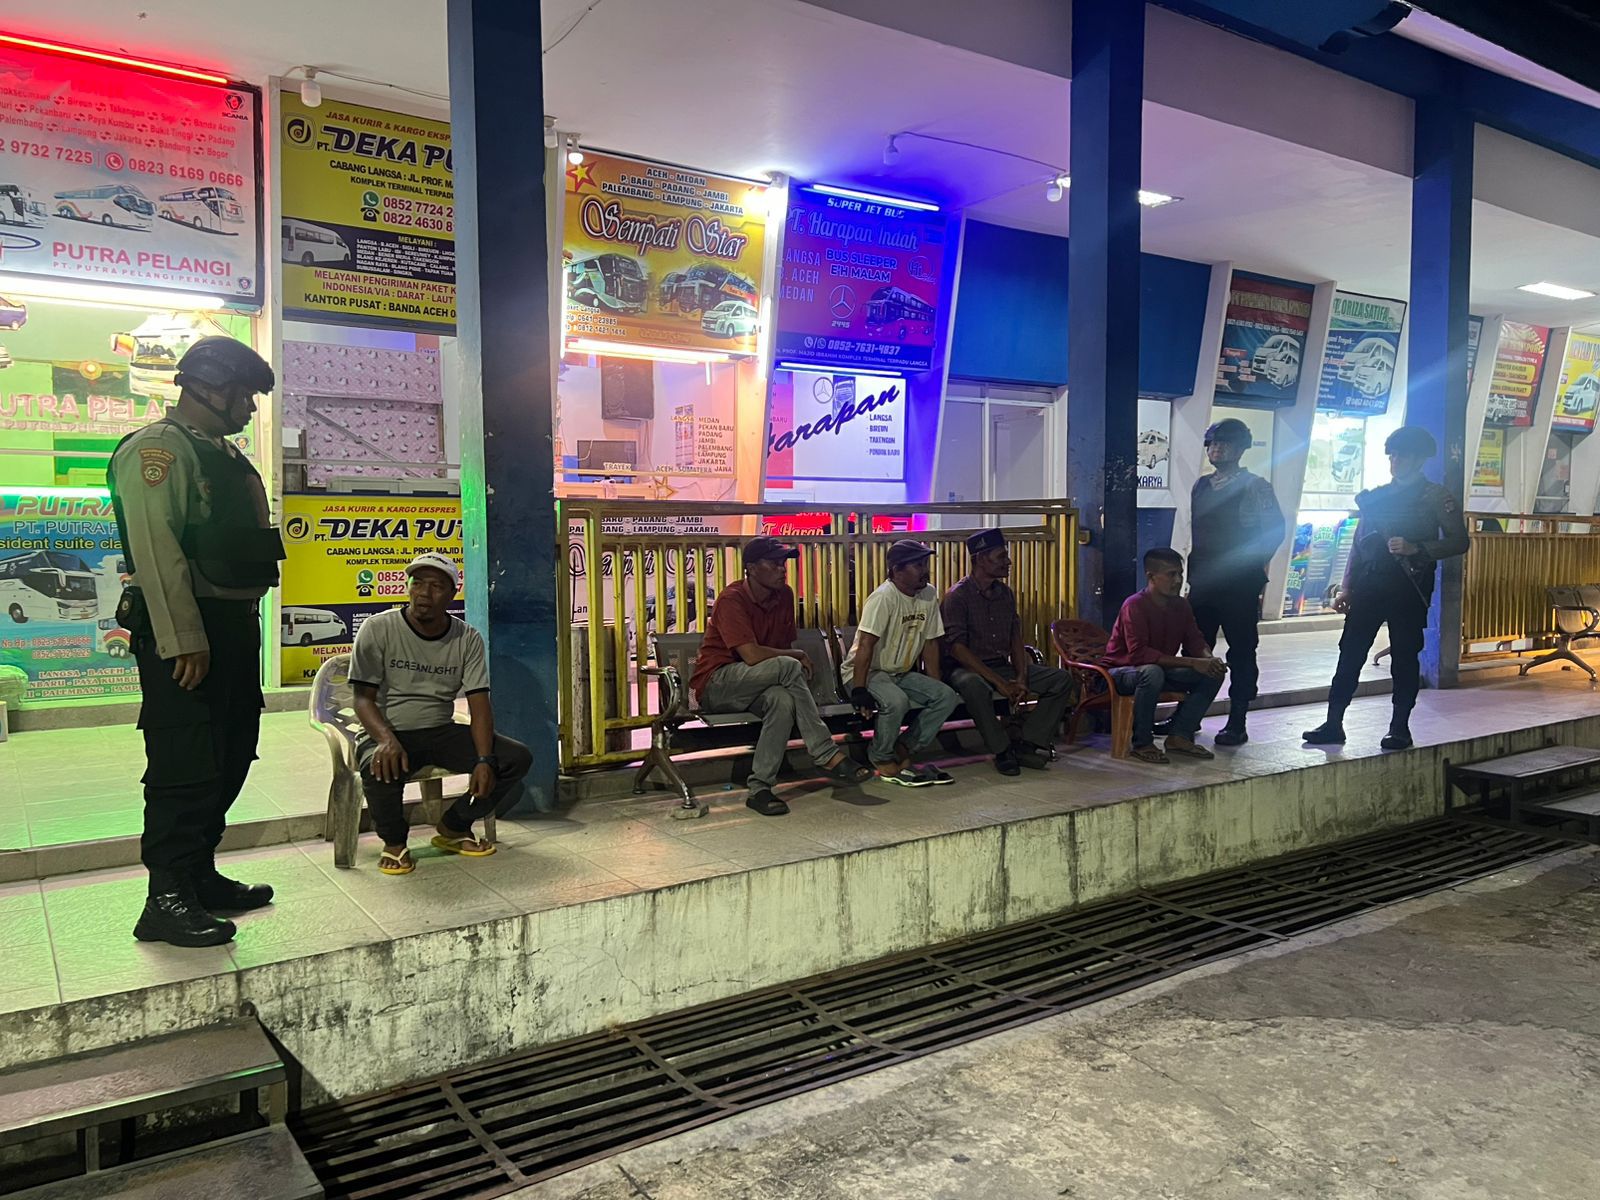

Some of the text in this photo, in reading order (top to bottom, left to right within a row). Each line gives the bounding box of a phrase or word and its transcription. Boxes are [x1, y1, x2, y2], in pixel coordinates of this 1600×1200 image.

[222, 112, 248, 120] SCANIA
[326, 111, 351, 123] JASA
[352, 116, 384, 129] KURIR
[384, 122, 392, 130] &
[393, 123, 426, 137] KARGO
[316, 141, 331, 152] PT.
[321, 125, 418, 166] DEKA
[10, 140, 244, 187] 9732 7225 0823 6169 0666
[330, 159, 445, 188] CABANG LANGSA JL. PROF.
[646, 168, 706, 186] ACEH MEDAN
[350, 176, 424, 196] KOMPLEK TERMINAL
[630, 176, 654, 188] BARU
[662, 182, 696, 196] PADANG
[702, 188, 729, 202] JAMBI
[383, 196, 413, 213] 0852
[416, 201, 444, 217] 7724
[602, 182, 744, 216] PALEMBANG LAMPUNG JAKARTA
[827, 198, 862, 212] SUPER
[864, 202, 882, 215] JET
[383, 211, 413, 227] 0822
[415, 215, 444, 231] 4630
[582, 198, 746, 259] Sempati Star
[808, 211, 920, 252] Harapan Indah
[398, 236, 434, 248] MELAYANI
[52, 241, 232, 277] PUTRA PELANGI
[826, 248, 898, 270] BUS SLEEPER
[52, 262, 233, 288] PT. PUTRA PELANGI PERKASA
[314, 270, 362, 284] MELAYANI
[363, 274, 420, 292] PENGIRIMAN
[420, 282, 450, 295] PAKET
[792, 268, 820, 286] ACEH
[851, 268, 892, 284] MALAM
[304, 292, 449, 318] KANTOR PUSAT BANDA ACEH
[396, 290, 425, 302] DARAT
[431, 294, 454, 305] LAUT
[831, 320, 850, 328] 2445
[828, 339, 900, 356] 0852-7631-4837
[870, 414, 892, 422] LANGSA
[604, 462, 632, 470] TRAYEK
[386, 506, 417, 514] KARGO
[418, 506, 457, 514] EKSPRES
[13, 520, 106, 534] PT. PUTRA
[318, 518, 410, 541] DEKA
[633, 526, 676, 534] LAMPUNG
[54, 536, 95, 550] suite
[314, 534, 328, 542] PT.
[326, 546, 460, 556] CABANG LANGSA JL. MAJID
[346, 558, 380, 566] KOMPLEK
[377, 572, 405, 582] 0852
[377, 585, 405, 596] 0822
[39, 669, 80, 680] LANGSA
[73, 678, 100, 687] PAYA
[42, 686, 104, 698] PALEMBANG
